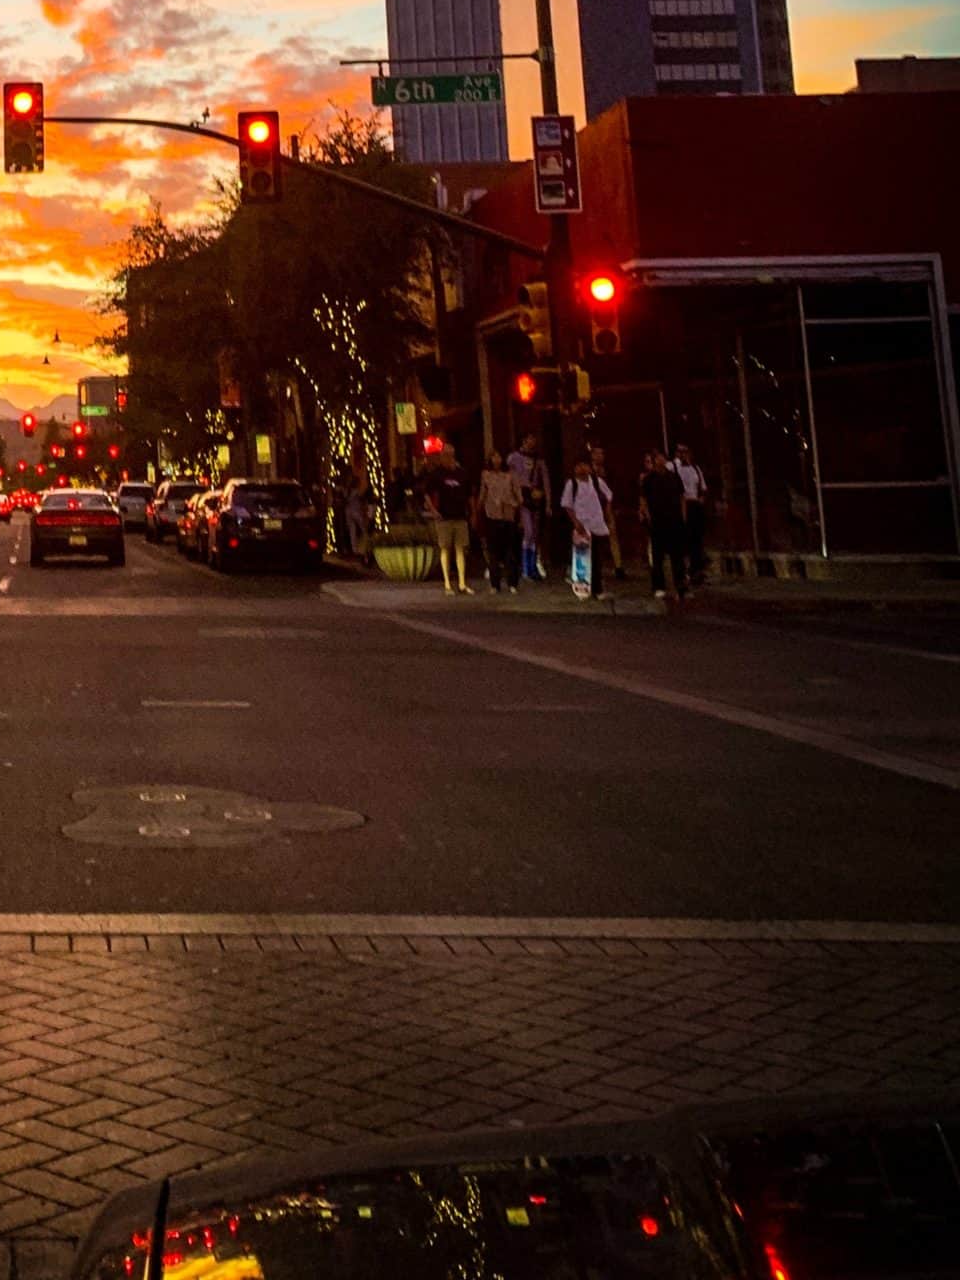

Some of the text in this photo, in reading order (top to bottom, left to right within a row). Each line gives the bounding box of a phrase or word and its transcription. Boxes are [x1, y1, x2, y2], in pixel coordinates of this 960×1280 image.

[376, 75, 492, 102] N 6th Ave
[488, 88, 497, 101] E
